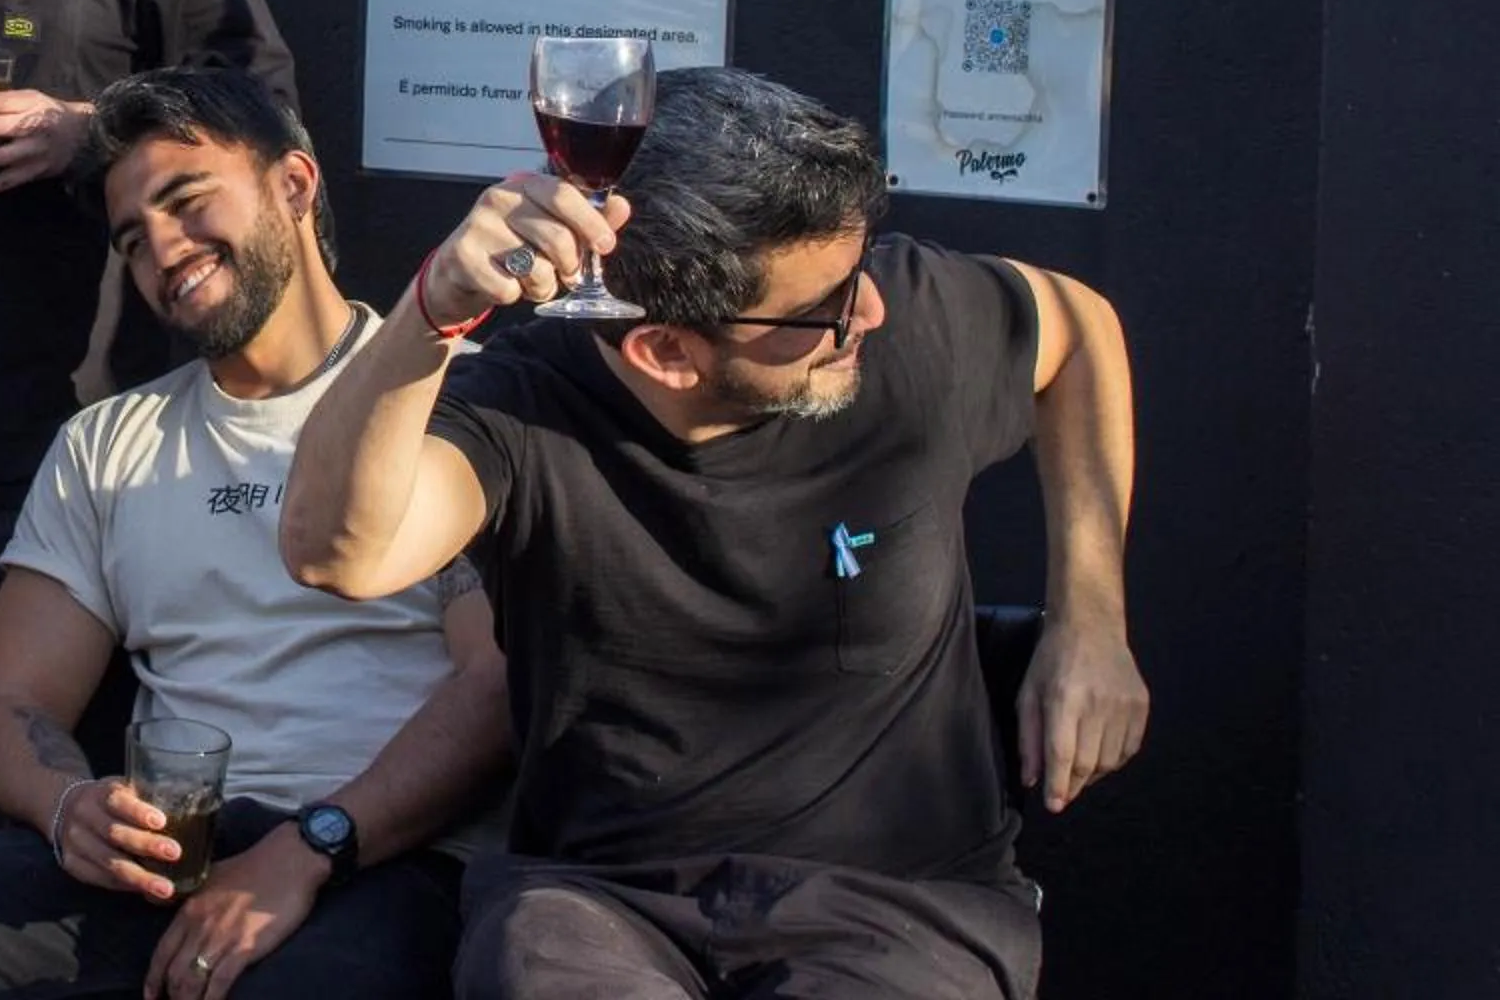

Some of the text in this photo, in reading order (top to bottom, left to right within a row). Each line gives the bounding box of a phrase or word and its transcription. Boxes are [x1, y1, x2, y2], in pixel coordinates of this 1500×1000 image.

[394, 16, 451, 33] Smoking
[456, 18, 466, 32] is
[471, 19, 523, 35] allowed
[528, 23, 540, 35] in
[545, 24, 572, 37] this
[661, 32, 699, 43] area.
[412, 82, 477, 97] permitido
[481, 86, 523, 99] fumar
[955, 149, 1026, 176] Palermo
[207, 482, 283, 515] 夜明
